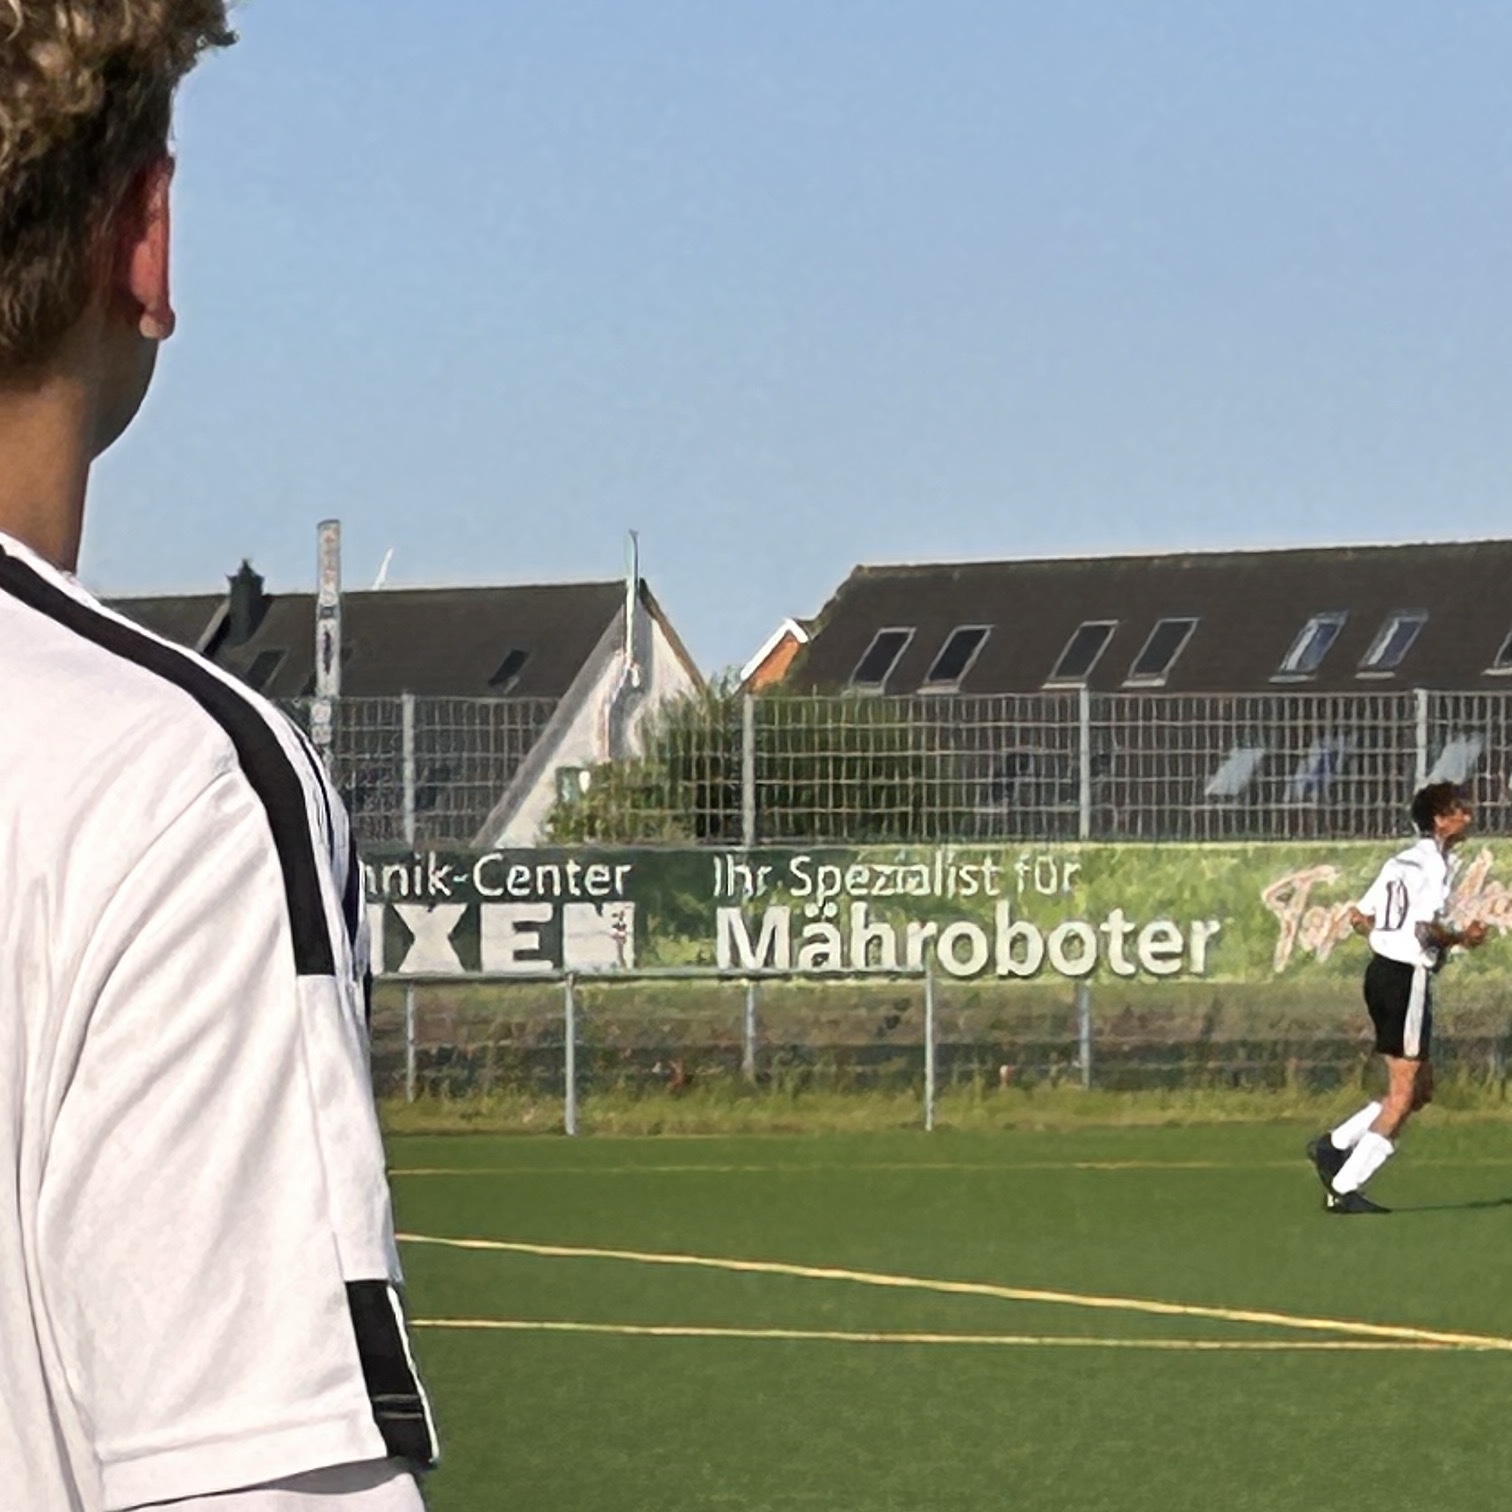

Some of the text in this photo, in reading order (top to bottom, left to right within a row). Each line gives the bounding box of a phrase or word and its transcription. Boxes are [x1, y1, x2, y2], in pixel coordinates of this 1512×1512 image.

[714, 850, 1082, 907] Ihr Spezialist für
[716, 900, 1220, 977] Mähroboter
